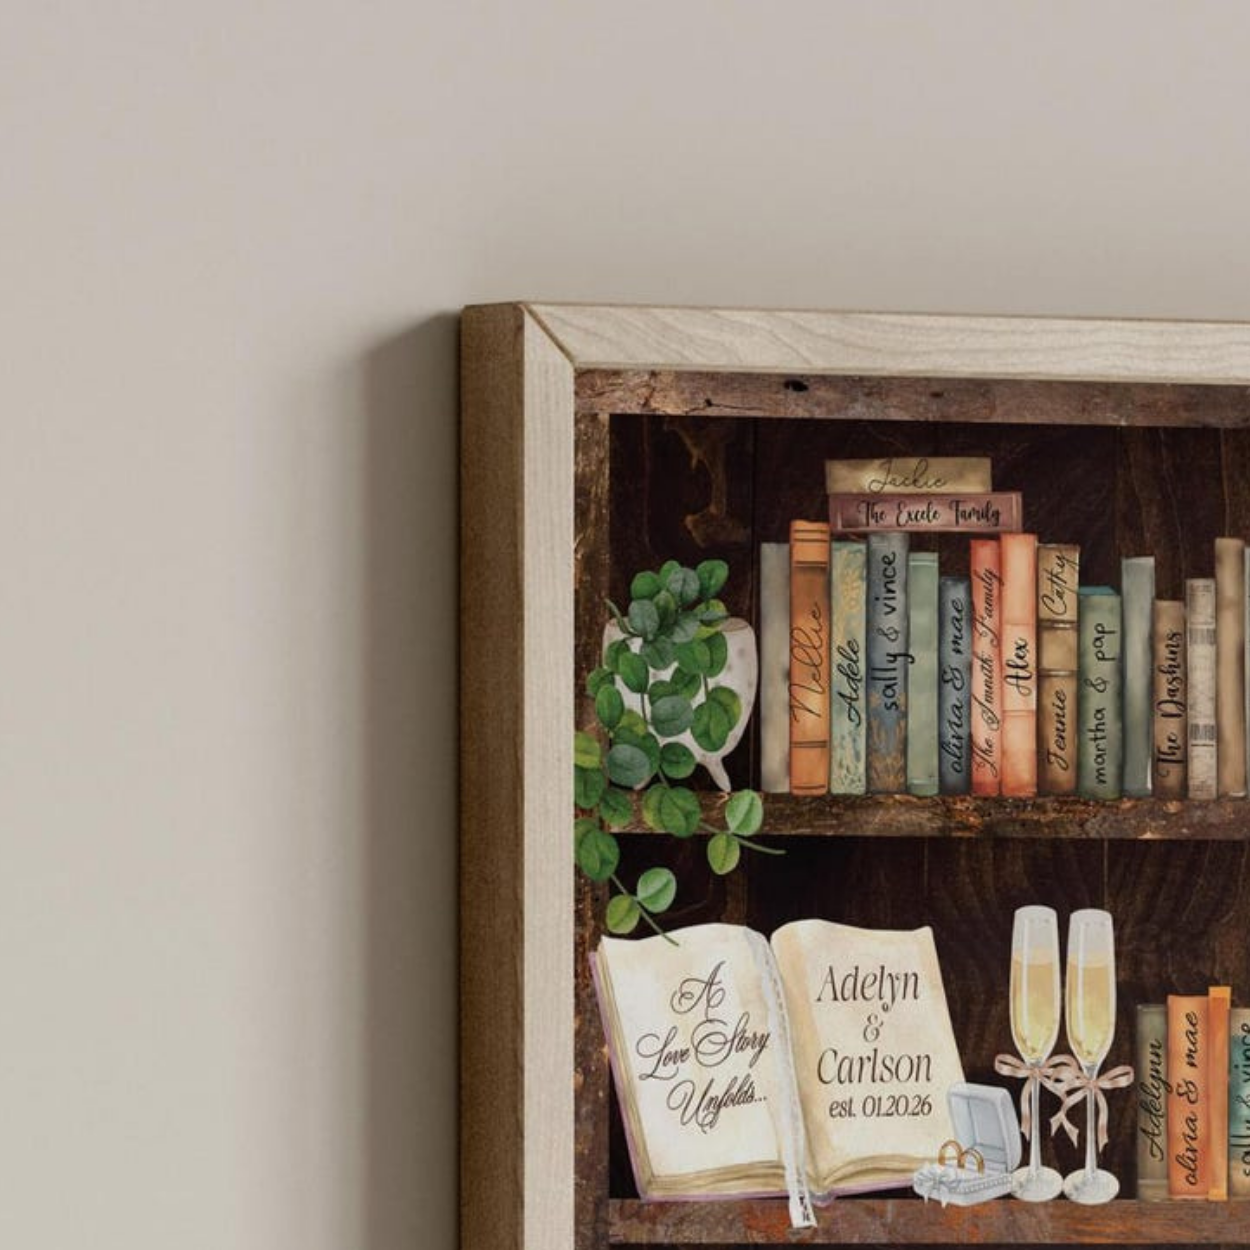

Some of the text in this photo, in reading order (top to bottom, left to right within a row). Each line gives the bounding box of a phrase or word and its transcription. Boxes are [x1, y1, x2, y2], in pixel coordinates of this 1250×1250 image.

[858, 501, 886, 526] The
[951, 500, 1001, 527] Family
[1042, 551, 1080, 616] Cathy
[788, 601, 826, 722] Nellie
[871, 552, 915, 711] sally & vince
[837, 638, 863, 727] Adele
[941, 598, 964, 773] olivia & mae
[1004, 637, 1033, 697] Alex
[1047, 688, 1070, 771] Jennie
[1083, 622, 1118, 784] martha & pap
[1156, 731, 1184, 778] The
[670, 960, 727, 1021] A
[816, 965, 919, 1013] Adelyn
[635, 1011, 771, 1081] Love Story
[863, 1014, 884, 1042] &
[817, 1048, 932, 1085] Carlson
[1140, 1039, 1173, 1161] Adelynn
[1175, 1011, 1199, 1186] olivia & mae
